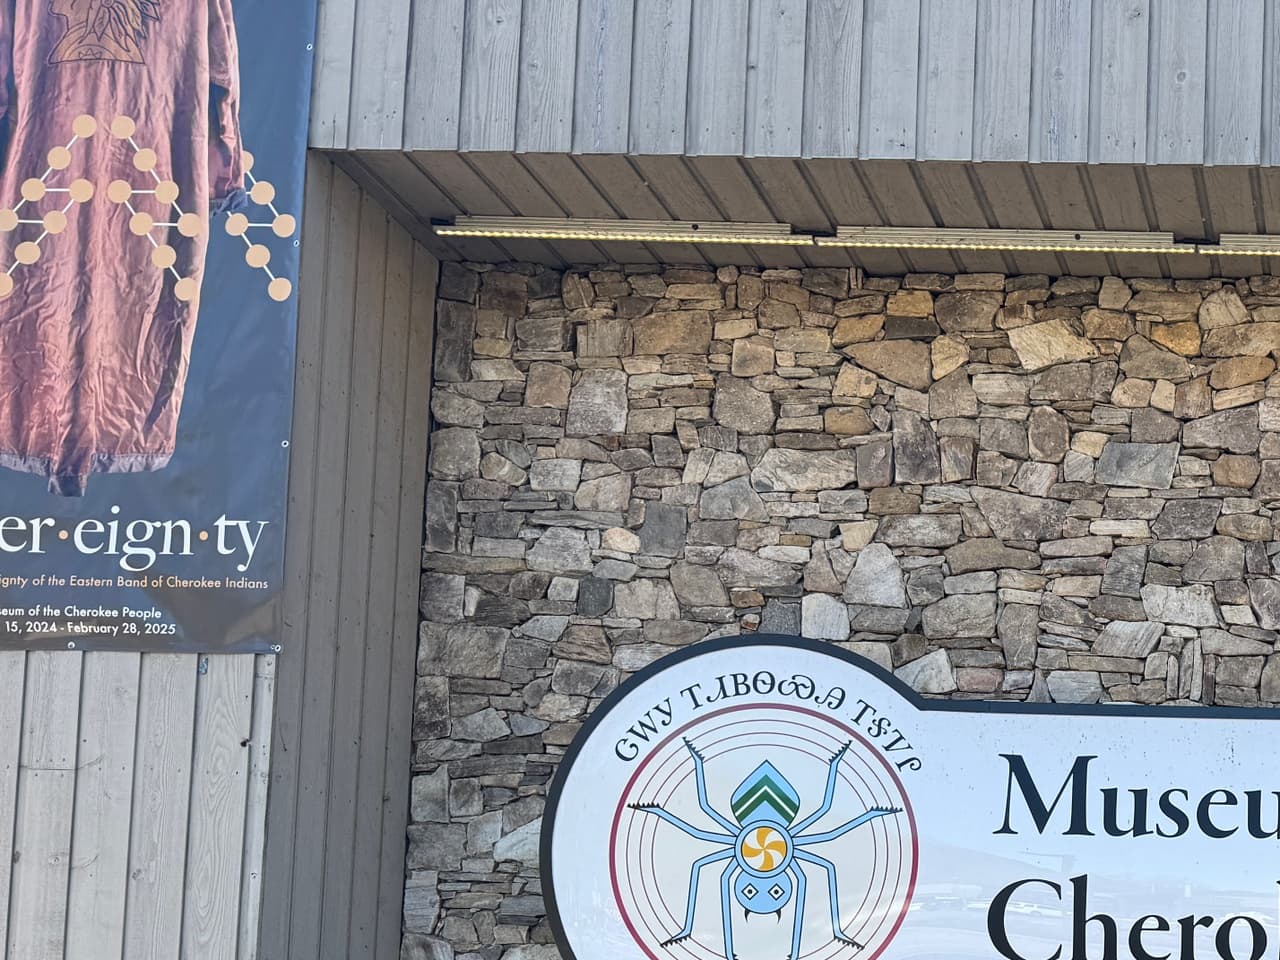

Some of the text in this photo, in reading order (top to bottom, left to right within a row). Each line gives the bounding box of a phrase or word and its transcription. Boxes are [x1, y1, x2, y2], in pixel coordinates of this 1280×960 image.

[32, 574, 45, 587] of
[48, 575, 65, 587] the
[69, 575, 113, 588] Eastern
[117, 576, 148, 588] Band
[151, 576, 163, 588] of
[166, 576, 222, 589] Cherokee
[225, 577, 269, 589] Indians
[28, 604, 41, 617] of
[43, 604, 61, 617] the
[64, 605, 119, 618] Cherokee
[122, 606, 162, 621] People
[5, 620, 22, 634] 15,
[26, 621, 58, 633] 2024
[67, 621, 119, 637] February
[122, 622, 141, 636] 28,
[144, 623, 176, 635] 2025
